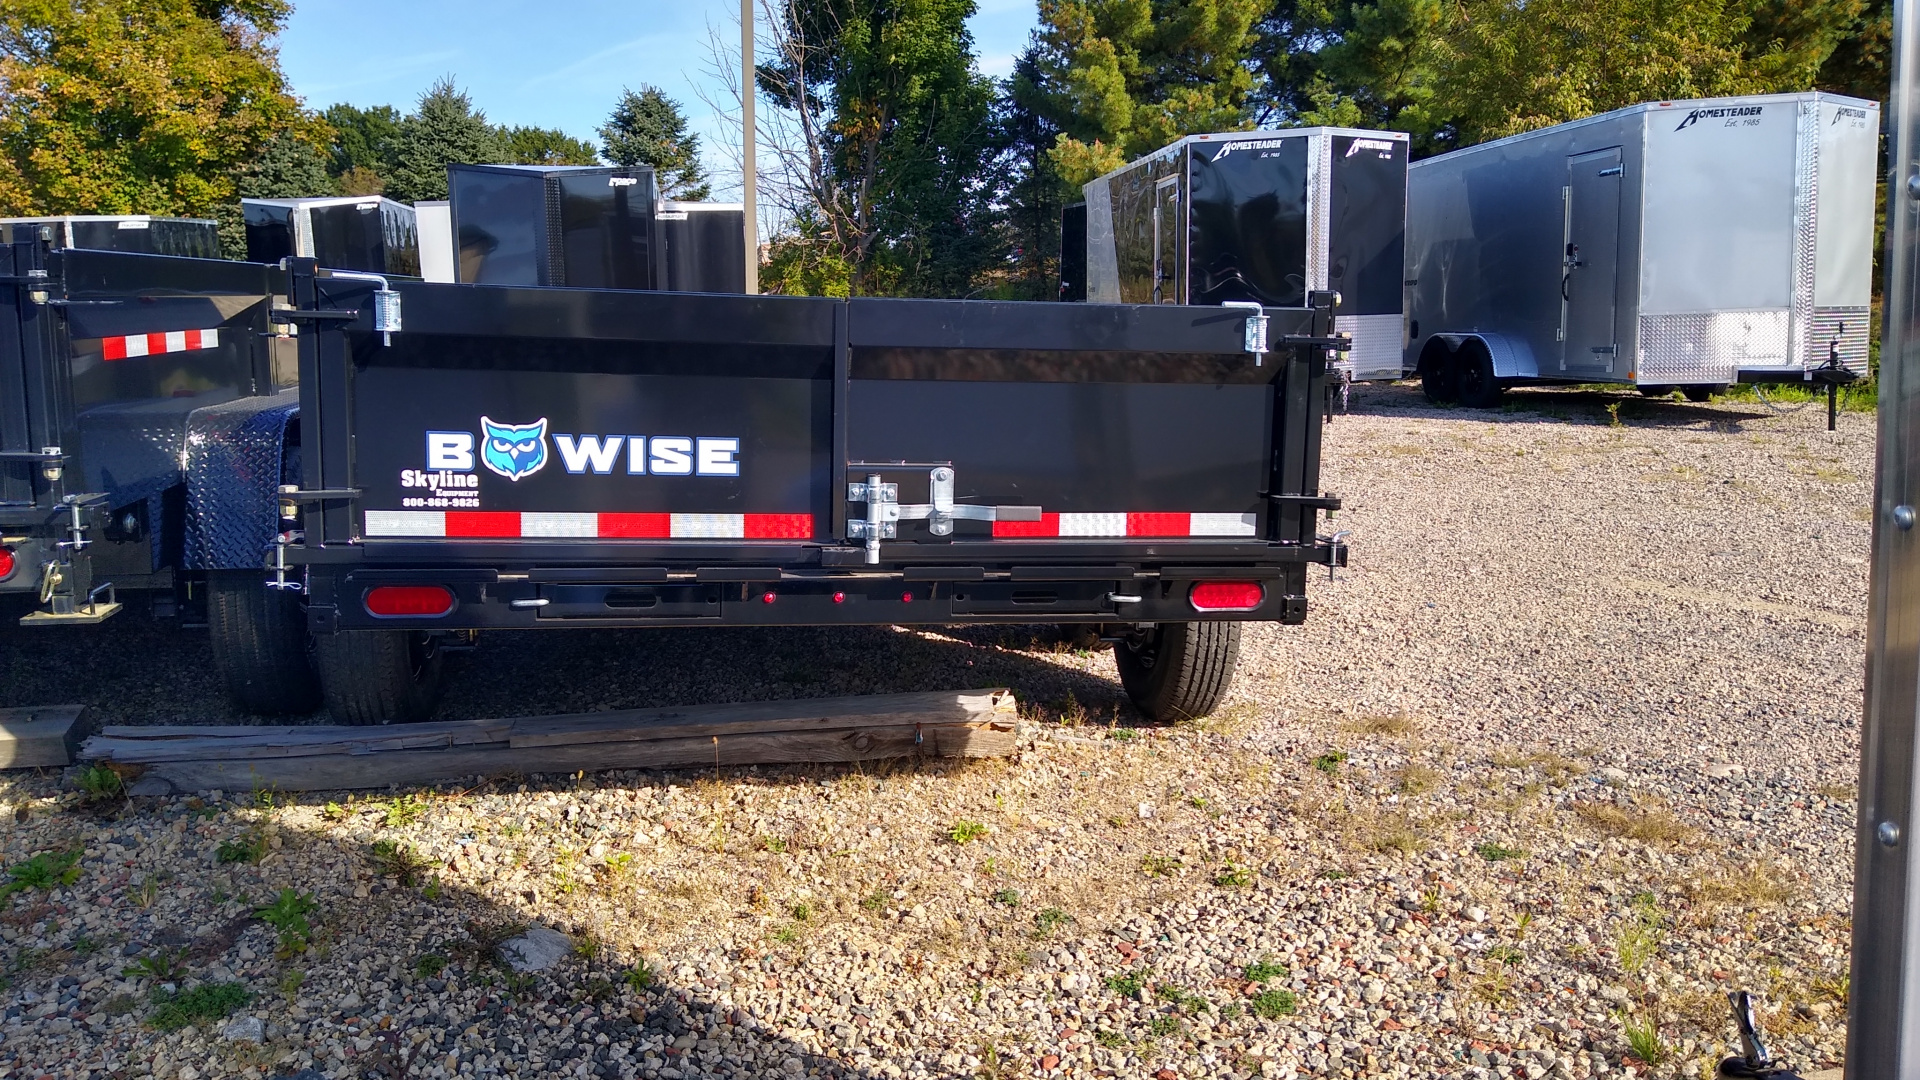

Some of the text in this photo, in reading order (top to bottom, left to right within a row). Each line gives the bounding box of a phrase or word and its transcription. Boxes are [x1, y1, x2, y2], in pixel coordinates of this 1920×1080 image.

[1674, 107, 1762, 132] HOMESTEADER
[1742, 118, 1761, 127] 1985
[1211, 140, 1282, 162] HOMESTEADER
[426, 430, 740, 477] B WISE
[401, 469, 479, 491] Skyline
[402, 497, 480, 507] 800-868-9826
[435, 488, 479, 497] EQUIPMENT
